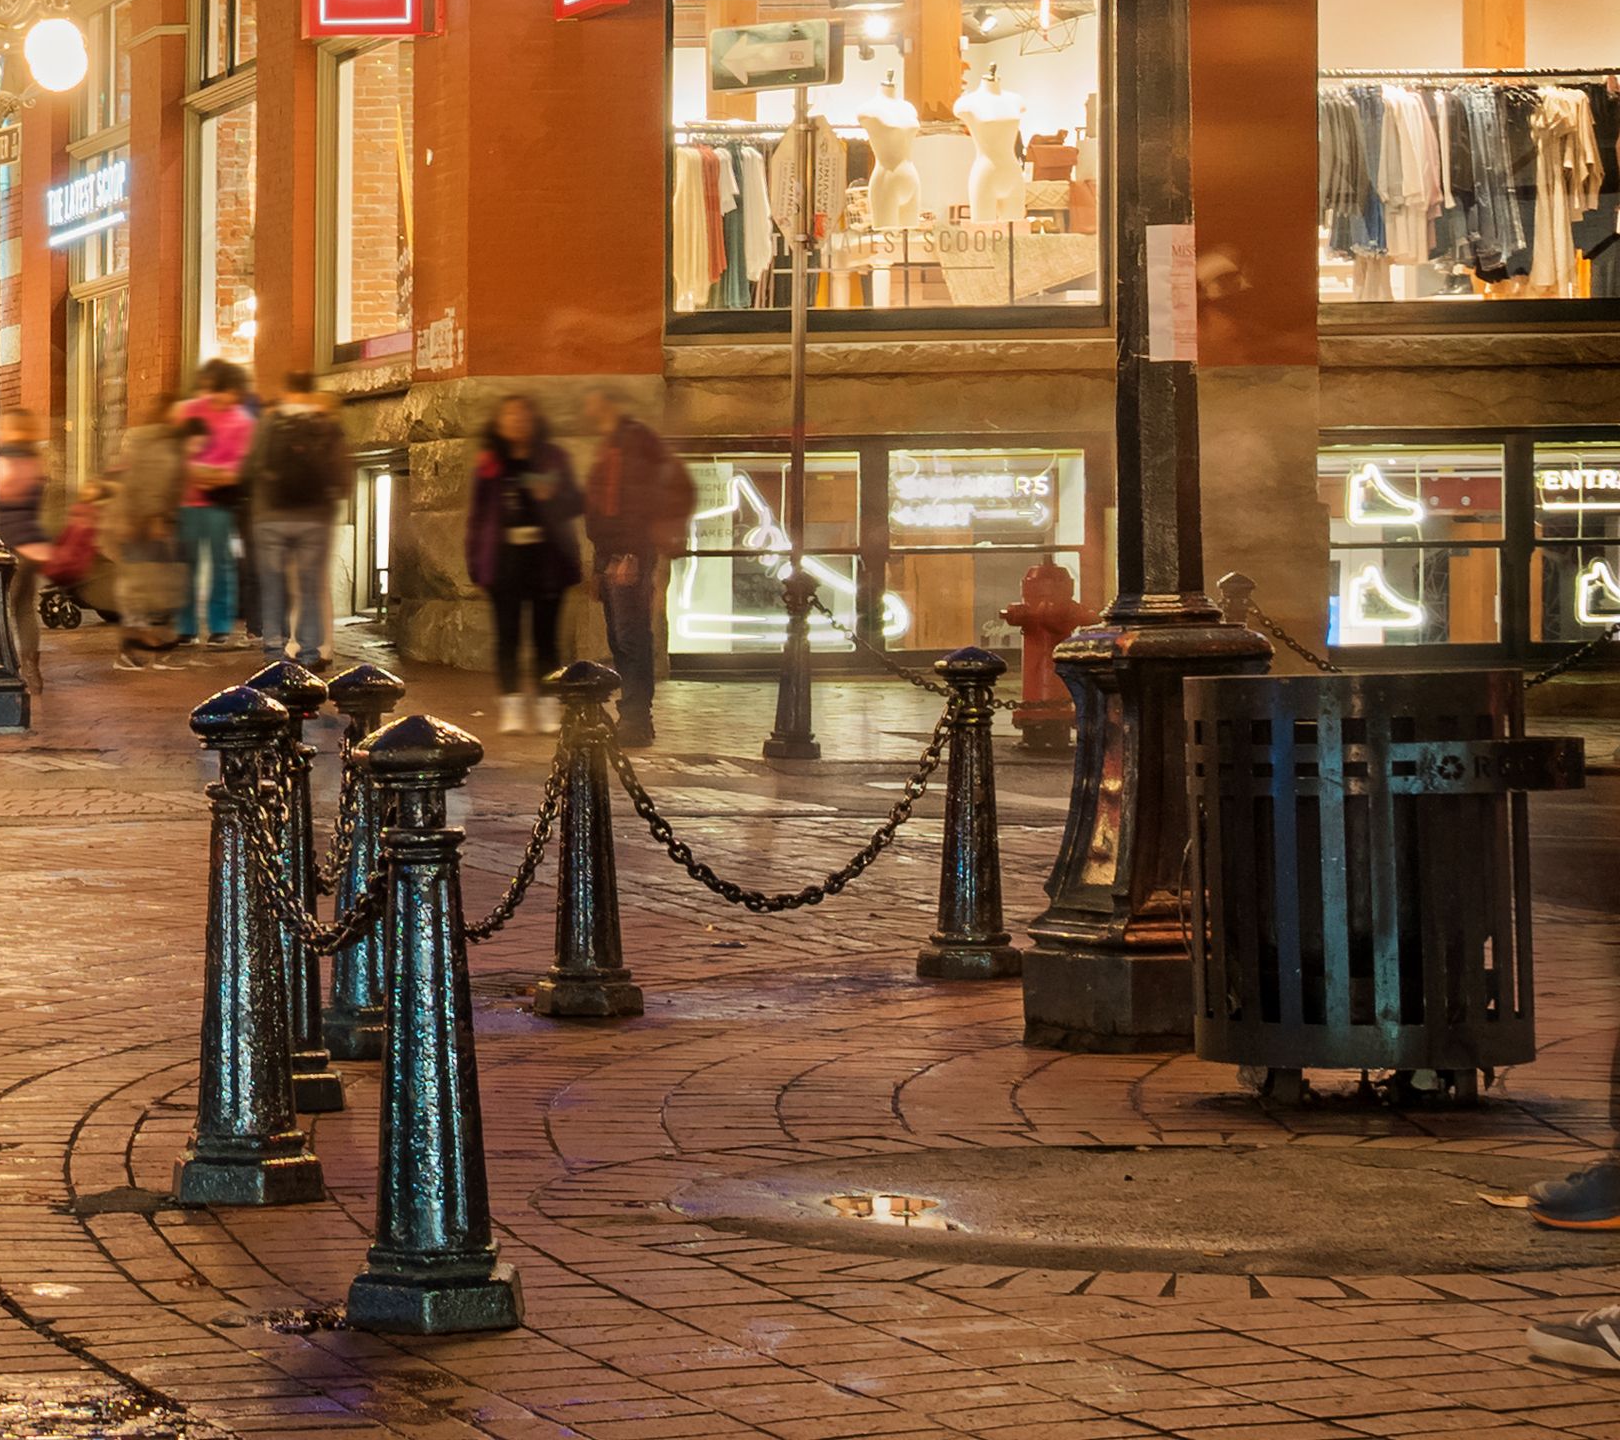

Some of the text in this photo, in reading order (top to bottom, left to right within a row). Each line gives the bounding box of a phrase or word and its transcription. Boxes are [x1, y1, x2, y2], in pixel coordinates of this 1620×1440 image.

[47, 160, 126, 226] THE LATEST SCOOP
[923, 229, 1004, 254] SCOOP
